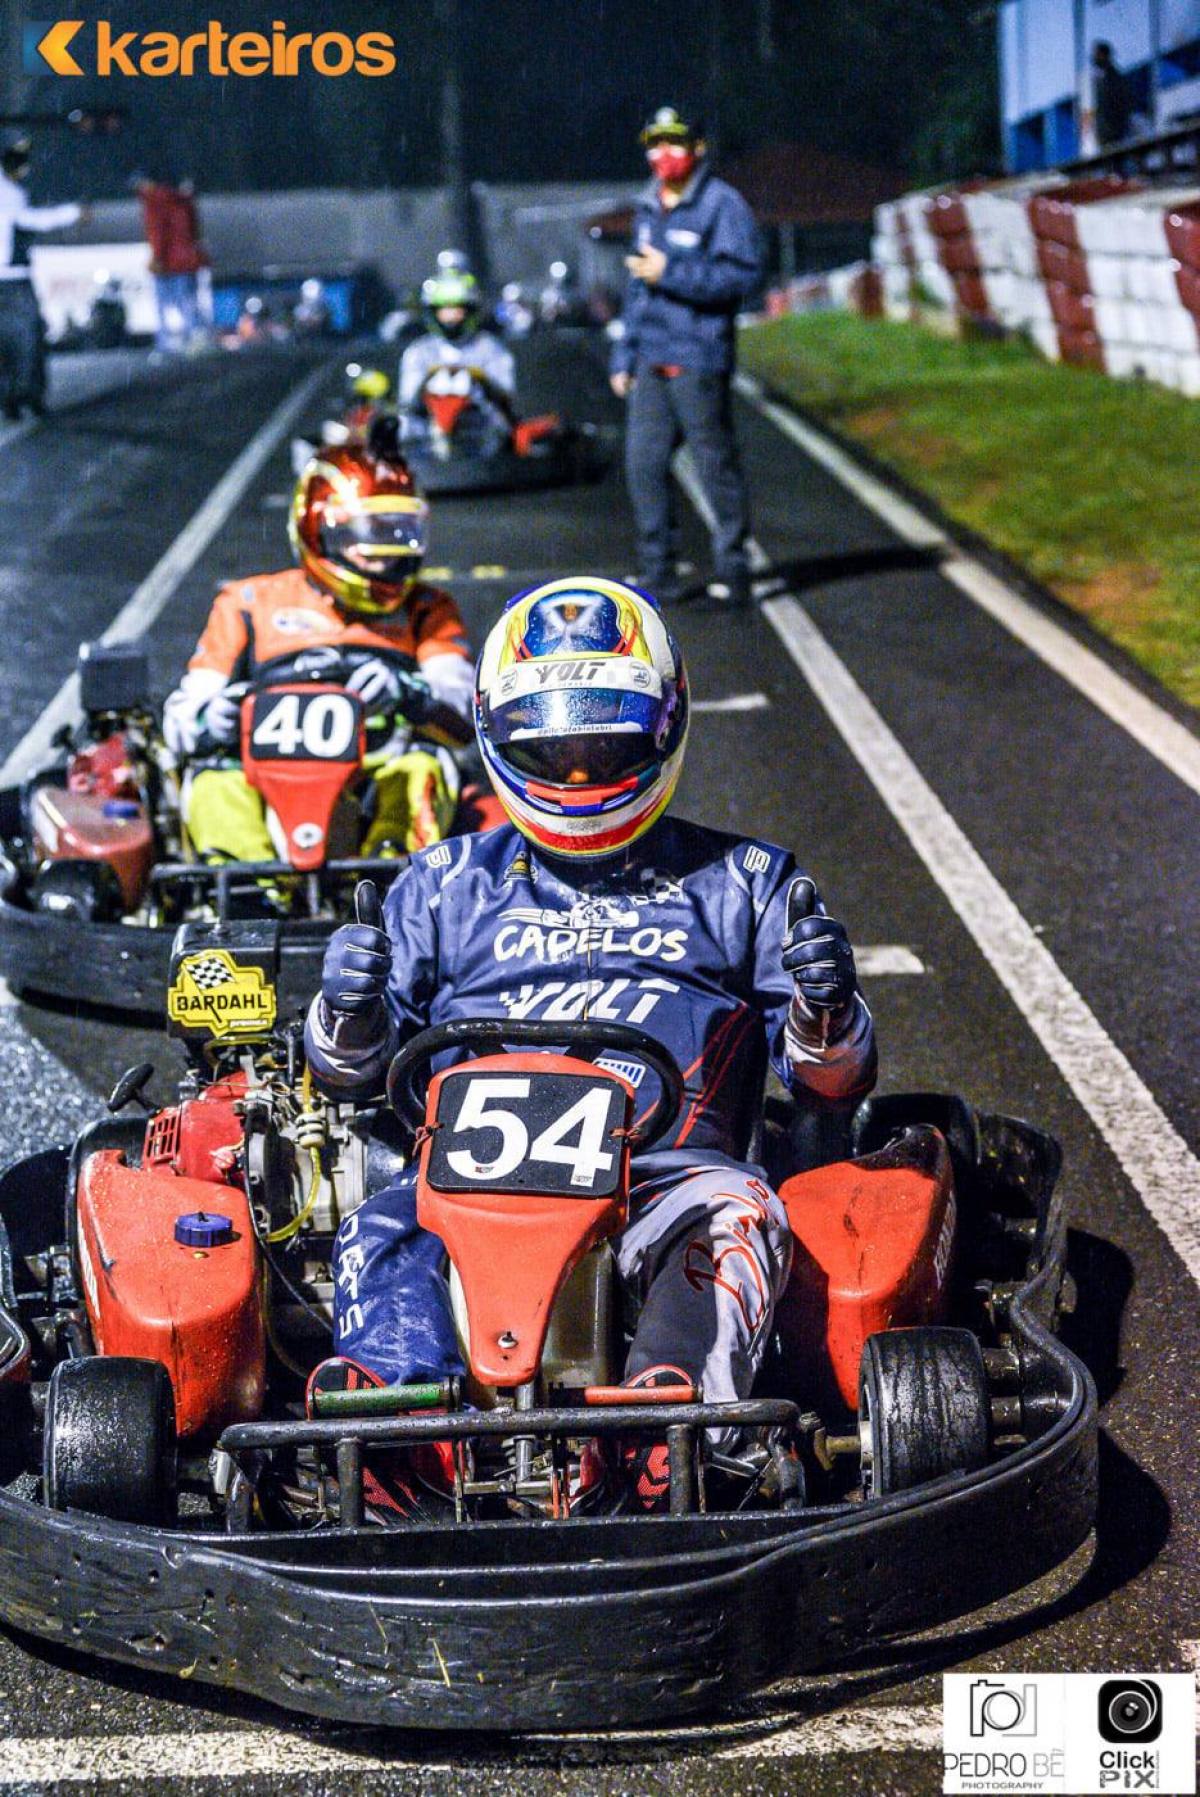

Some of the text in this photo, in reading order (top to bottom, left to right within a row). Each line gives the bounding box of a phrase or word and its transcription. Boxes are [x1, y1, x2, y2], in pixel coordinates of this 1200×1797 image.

[535, 662, 606, 684] VOLT
[253, 694, 354, 758] 40
[176, 993, 268, 1011] BARDAHL
[499, 978, 681, 1024] VOLT
[446, 1078, 614, 1188] 54
